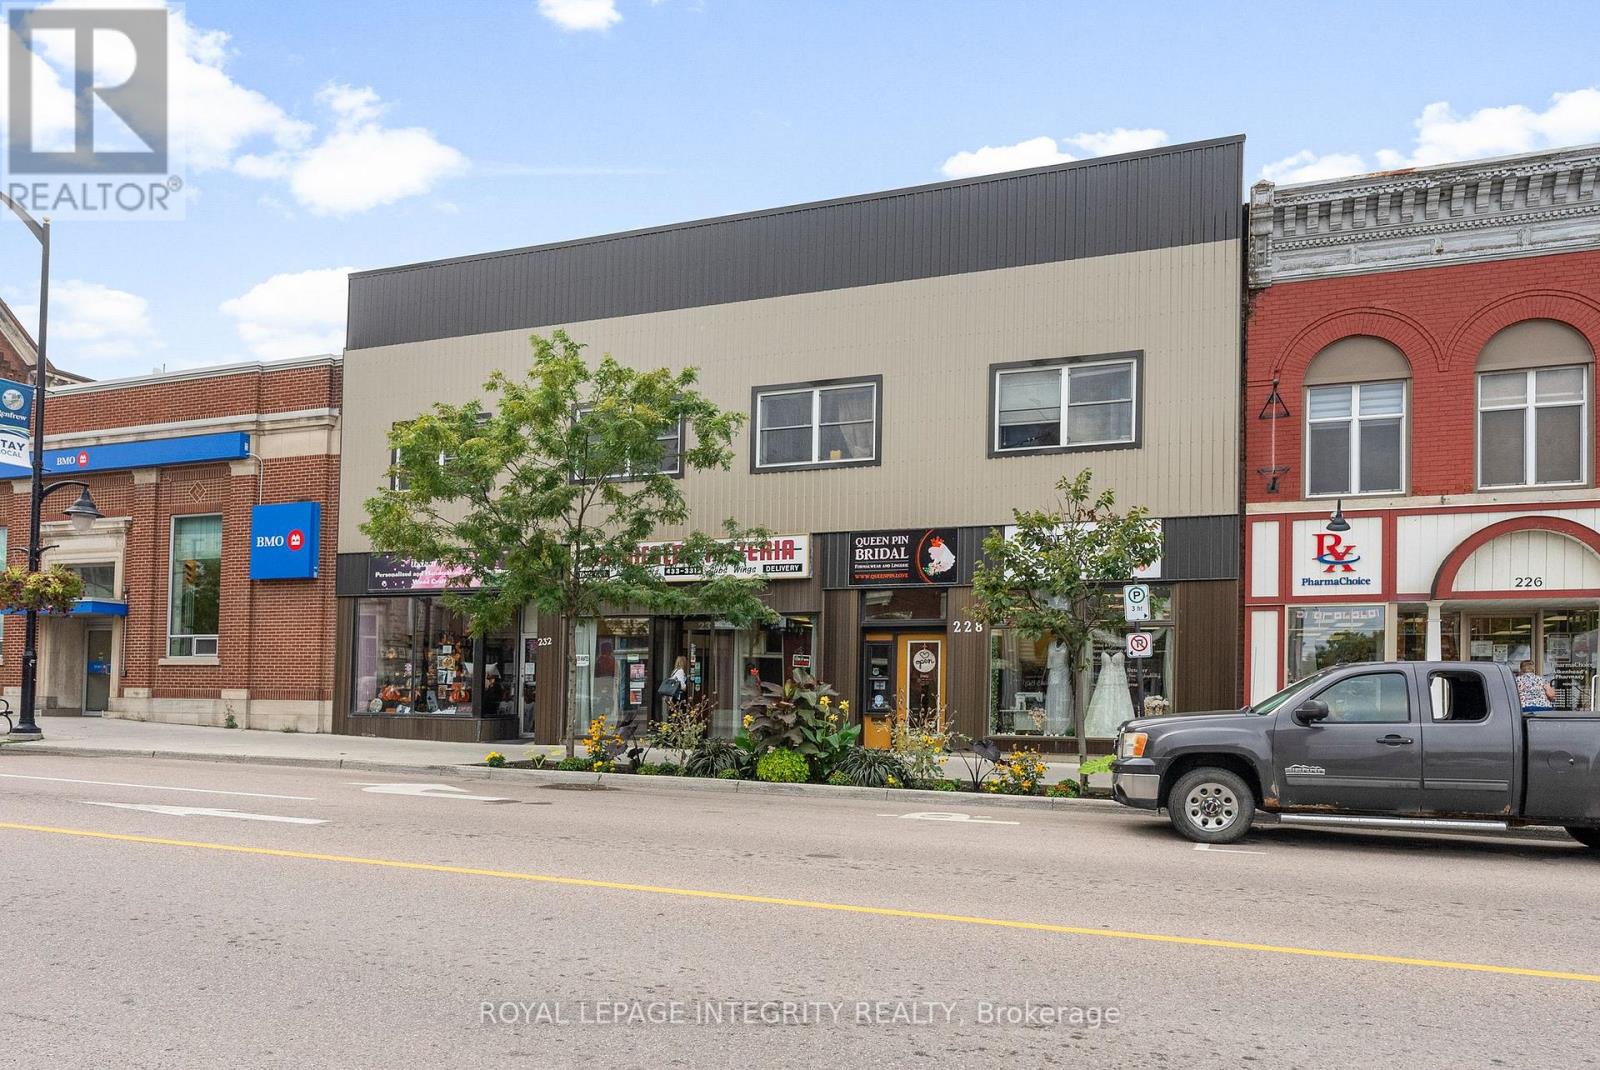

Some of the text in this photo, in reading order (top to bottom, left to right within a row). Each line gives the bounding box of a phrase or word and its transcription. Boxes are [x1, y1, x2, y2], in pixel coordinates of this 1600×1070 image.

[0, 440, 25, 451] TAY
[56, 456, 76, 466] BMO
[256, 535, 284, 548] BMO
[855, 535, 909, 547] QUEEN PIN
[855, 547, 909, 560] BRIDAL
[733, 565, 757, 574] Wings
[765, 565, 800, 573] DELIVERY
[1301, 576, 1371, 587] PharmaChoice
[1515, 576, 1543, 588] 226
[953, 620, 984, 633] 228
[538, 637, 552, 646] 232
[915, 658, 935, 670] open
